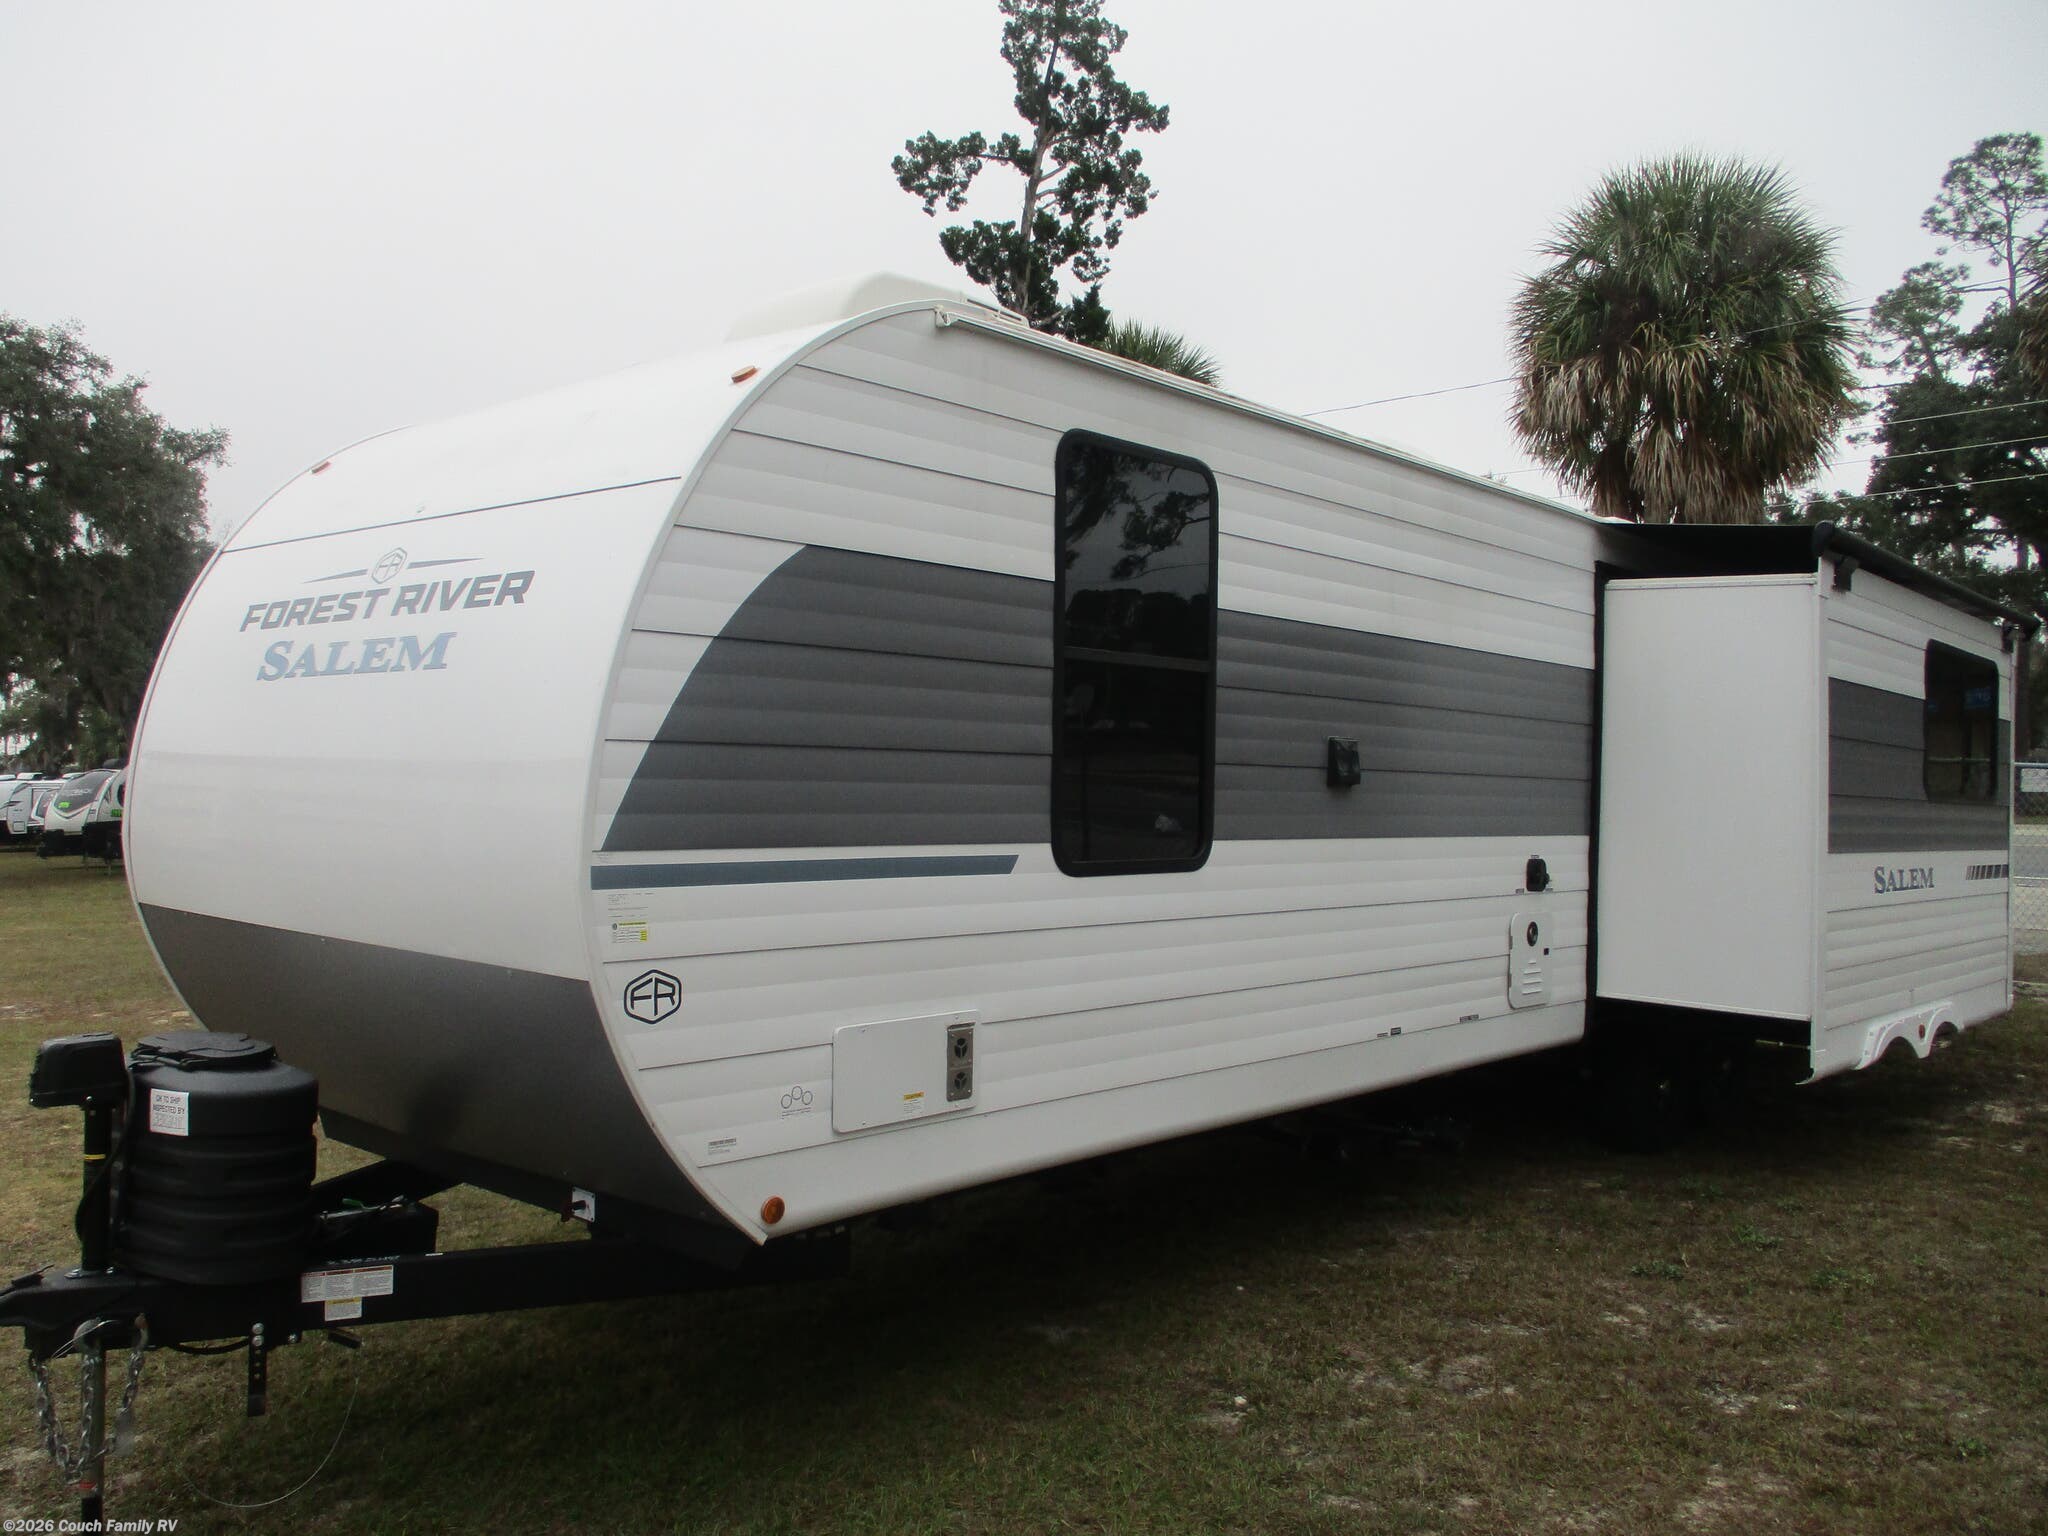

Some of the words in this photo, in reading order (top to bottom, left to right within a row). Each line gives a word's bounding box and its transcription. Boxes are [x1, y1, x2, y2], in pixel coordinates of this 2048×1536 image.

[239, 587, 391, 633] FOREST
[390, 570, 536, 617] RIVER
[256, 631, 458, 682] SALEM
[630, 976, 676, 1017] FR
